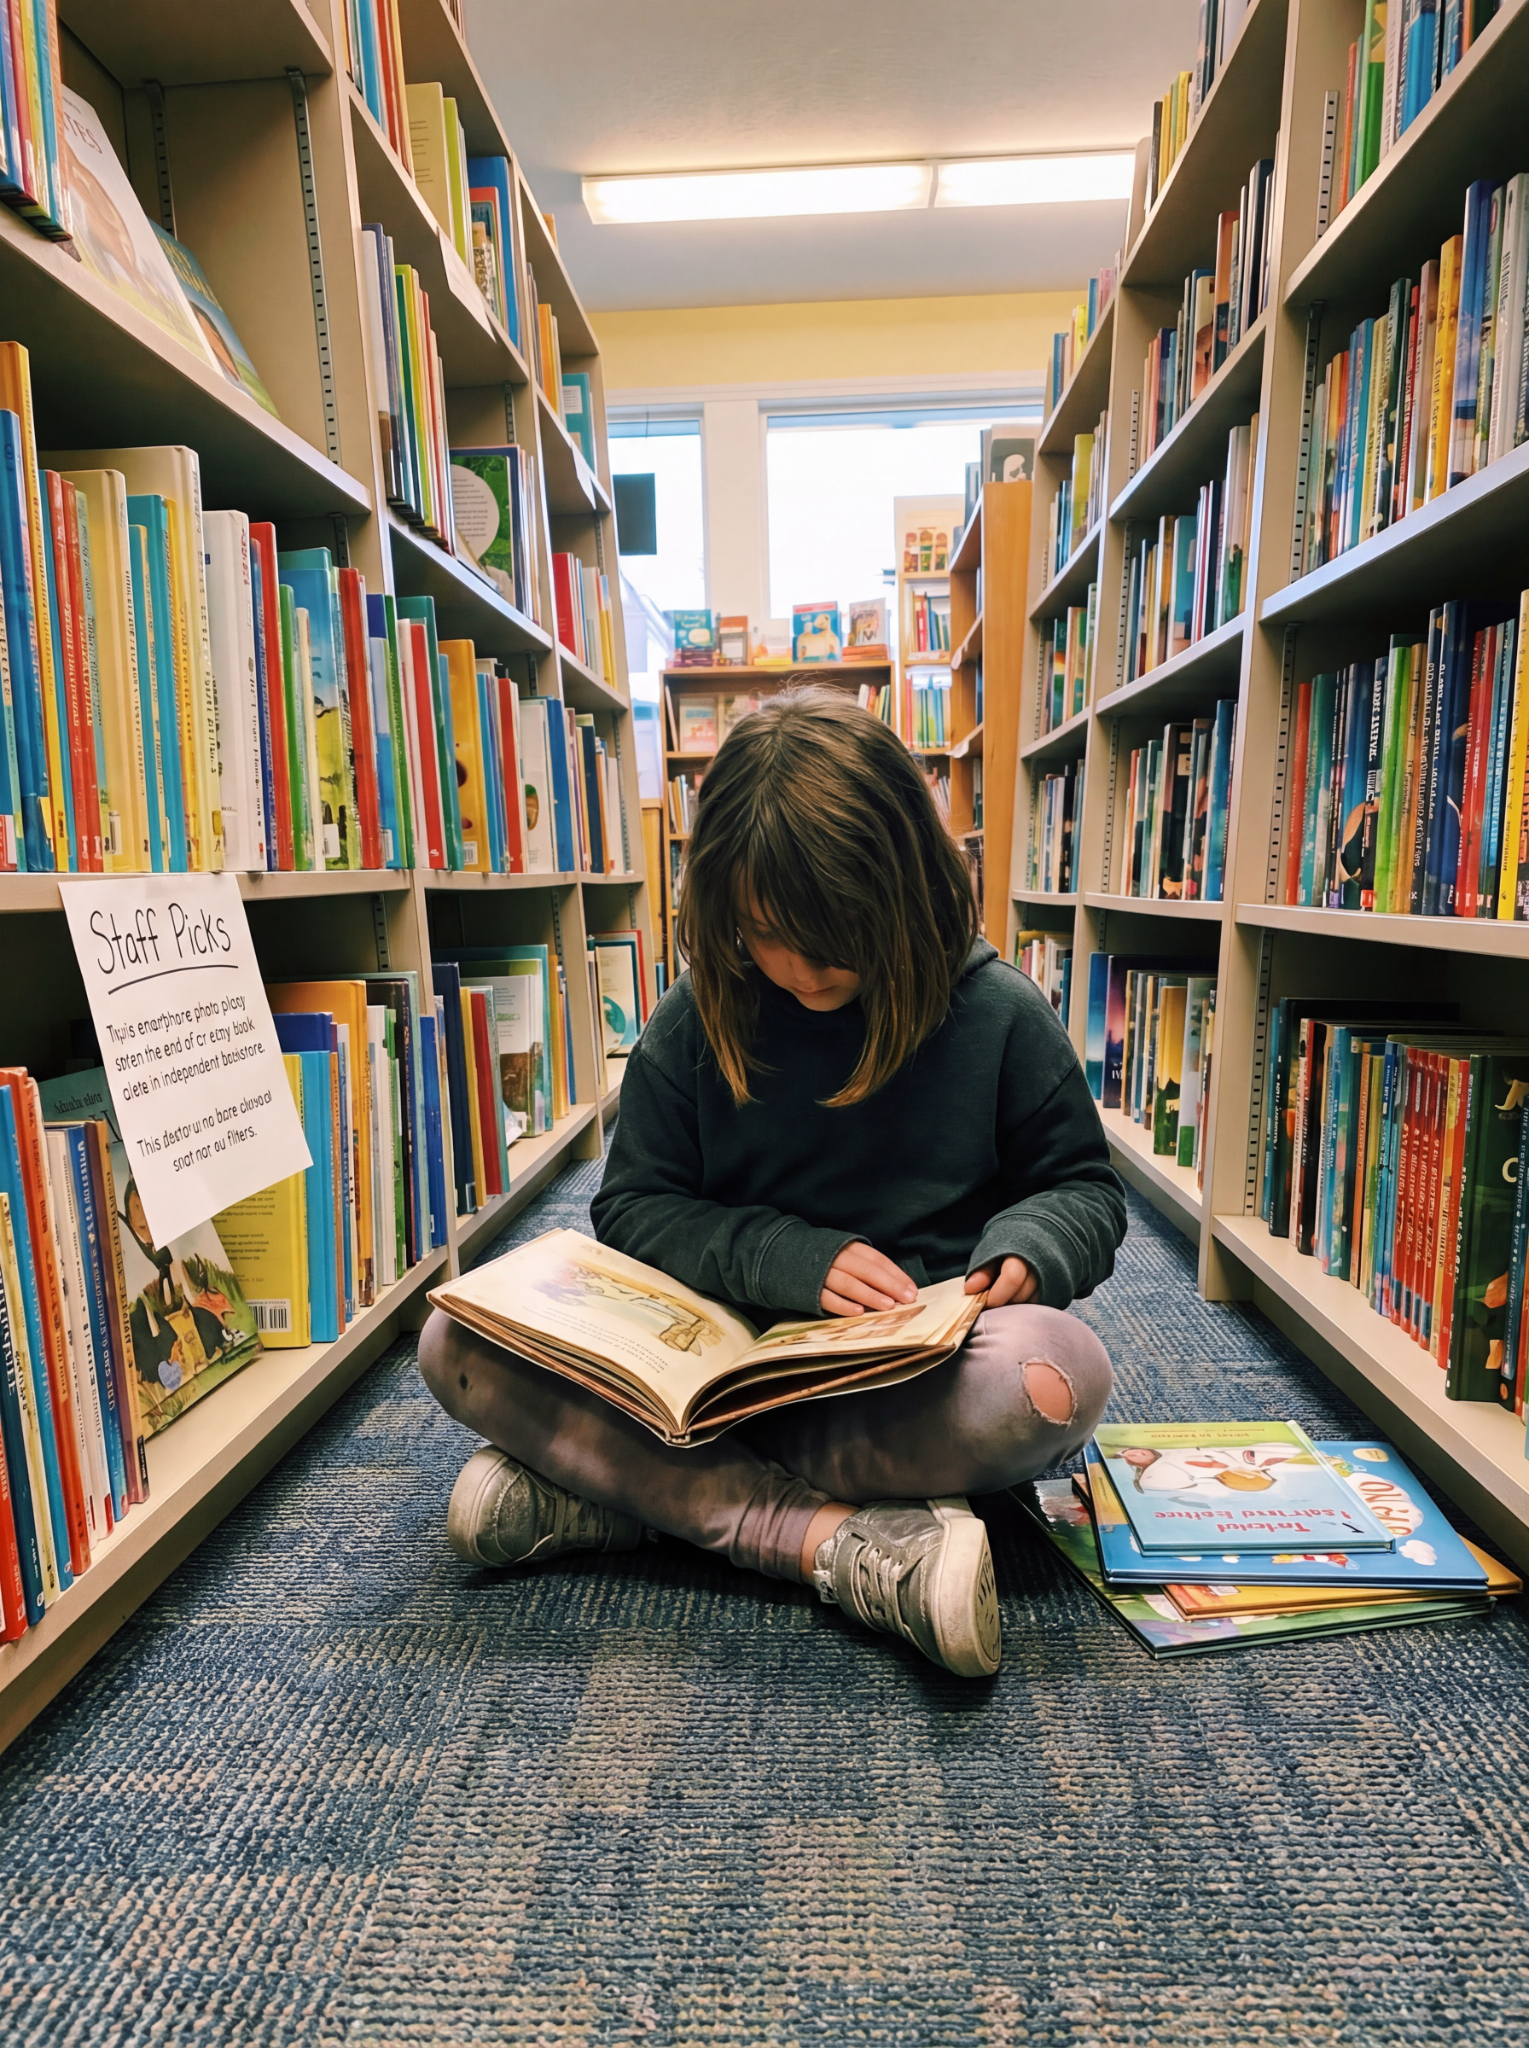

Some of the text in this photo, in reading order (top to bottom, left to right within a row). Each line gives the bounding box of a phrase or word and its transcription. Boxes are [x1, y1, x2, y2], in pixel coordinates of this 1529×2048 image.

[63, 112, 102, 154] TES
[90, 903, 231, 974] Staff Picks
[145, 1044, 162, 1063] the
[164, 1040, 183, 1057] end
[184, 1032, 194, 1050] of
[149, 1075, 161, 1091] in
[161, 1055, 220, 1086] independent
[137, 1137, 161, 1157] This
[202, 1115, 215, 1130] no
